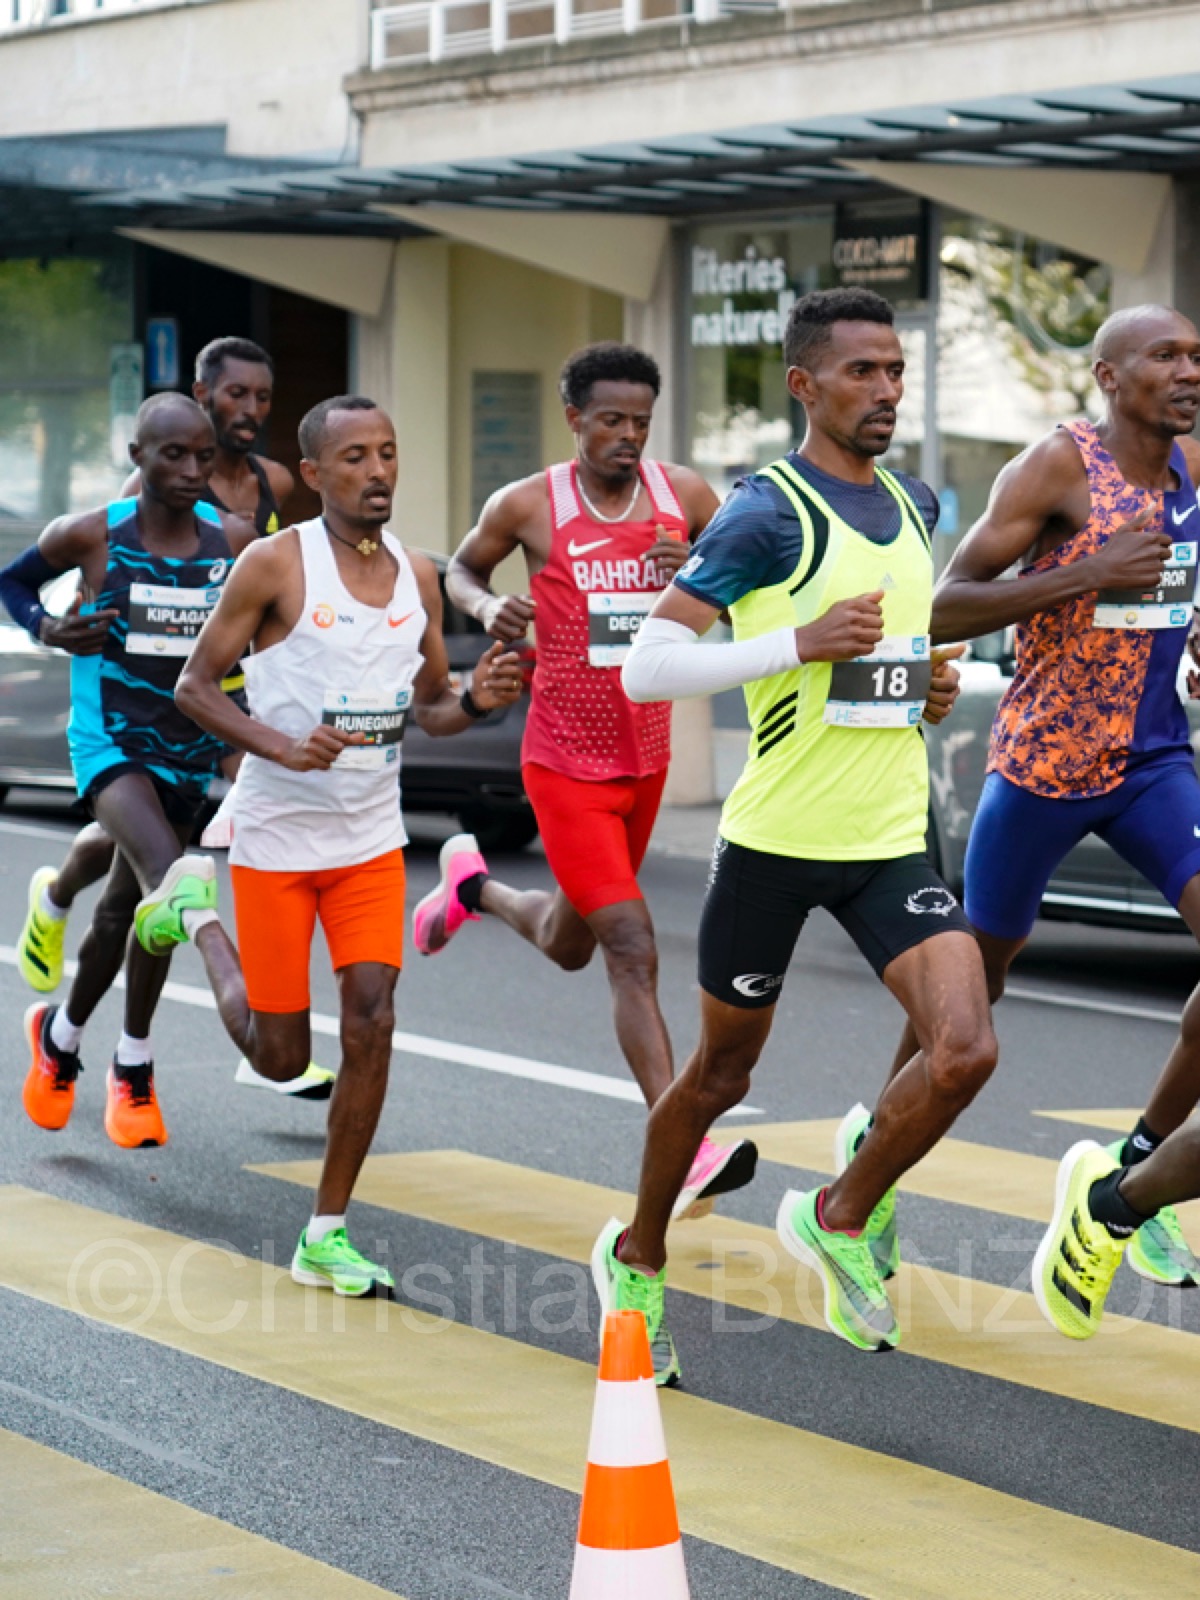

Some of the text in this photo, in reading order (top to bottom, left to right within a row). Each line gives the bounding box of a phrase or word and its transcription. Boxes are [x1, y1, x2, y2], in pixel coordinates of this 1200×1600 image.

[692, 245, 786, 293] literies
[572, 559, 672, 590] BAHRAI
[146, 607, 213, 624] KIPLAGA
[872, 666, 908, 697] 18
